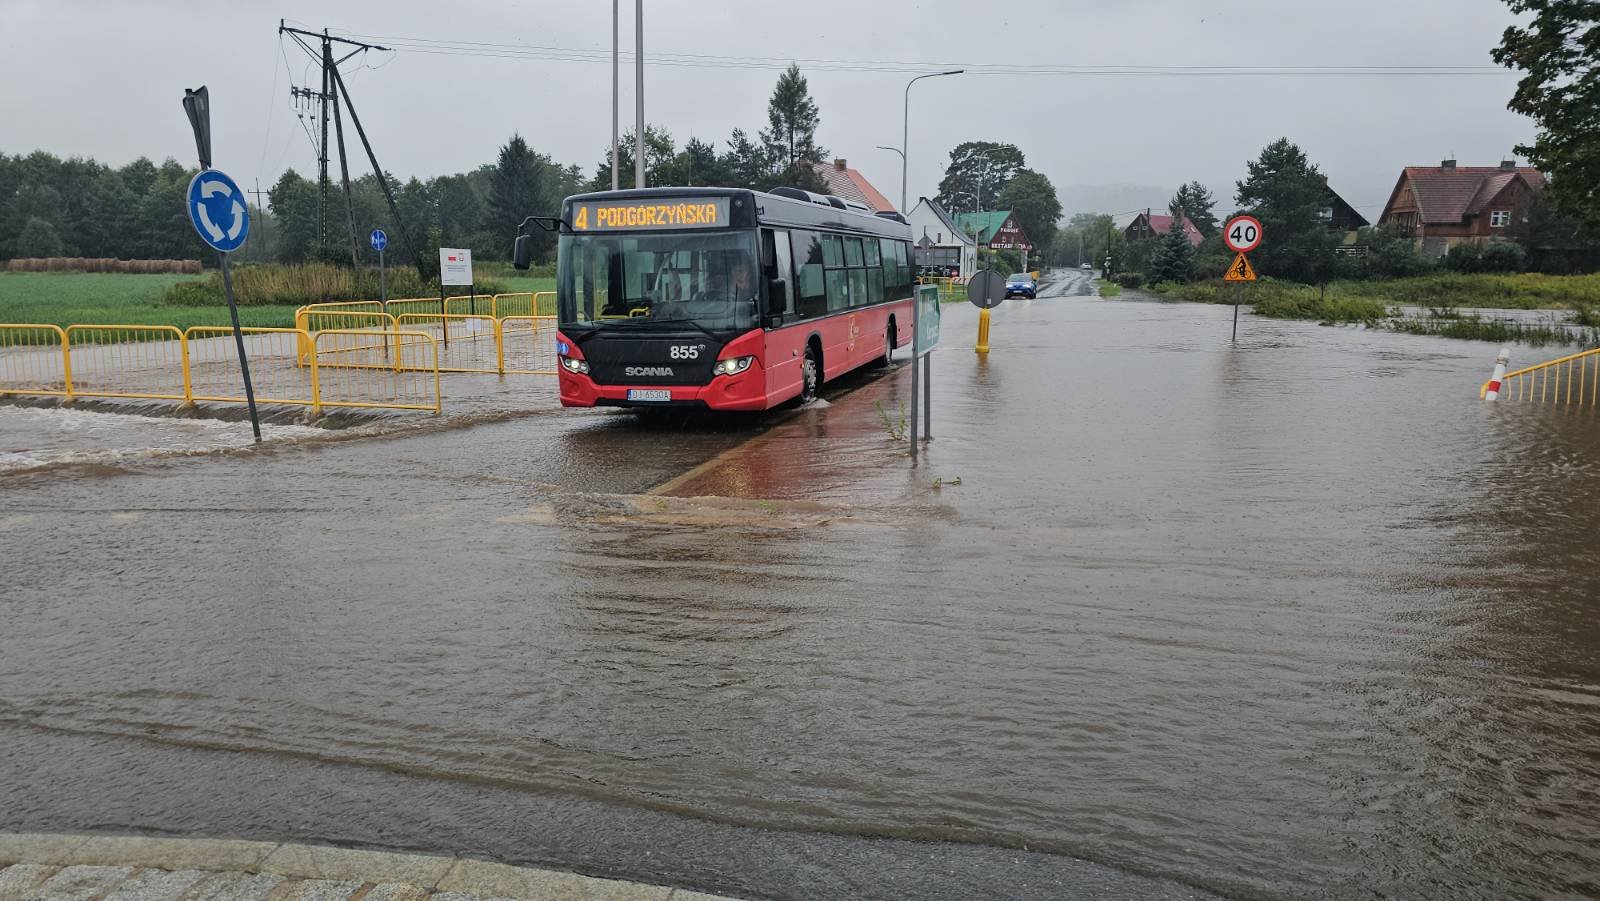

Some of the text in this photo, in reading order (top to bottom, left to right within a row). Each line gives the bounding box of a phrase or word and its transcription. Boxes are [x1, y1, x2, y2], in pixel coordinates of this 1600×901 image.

[574, 202, 717, 230] 4 PODGÓRZYŃSKA
[1230, 226, 1257, 242] 40
[670, 345, 699, 360] 855
[625, 366, 674, 377] SCANIA
